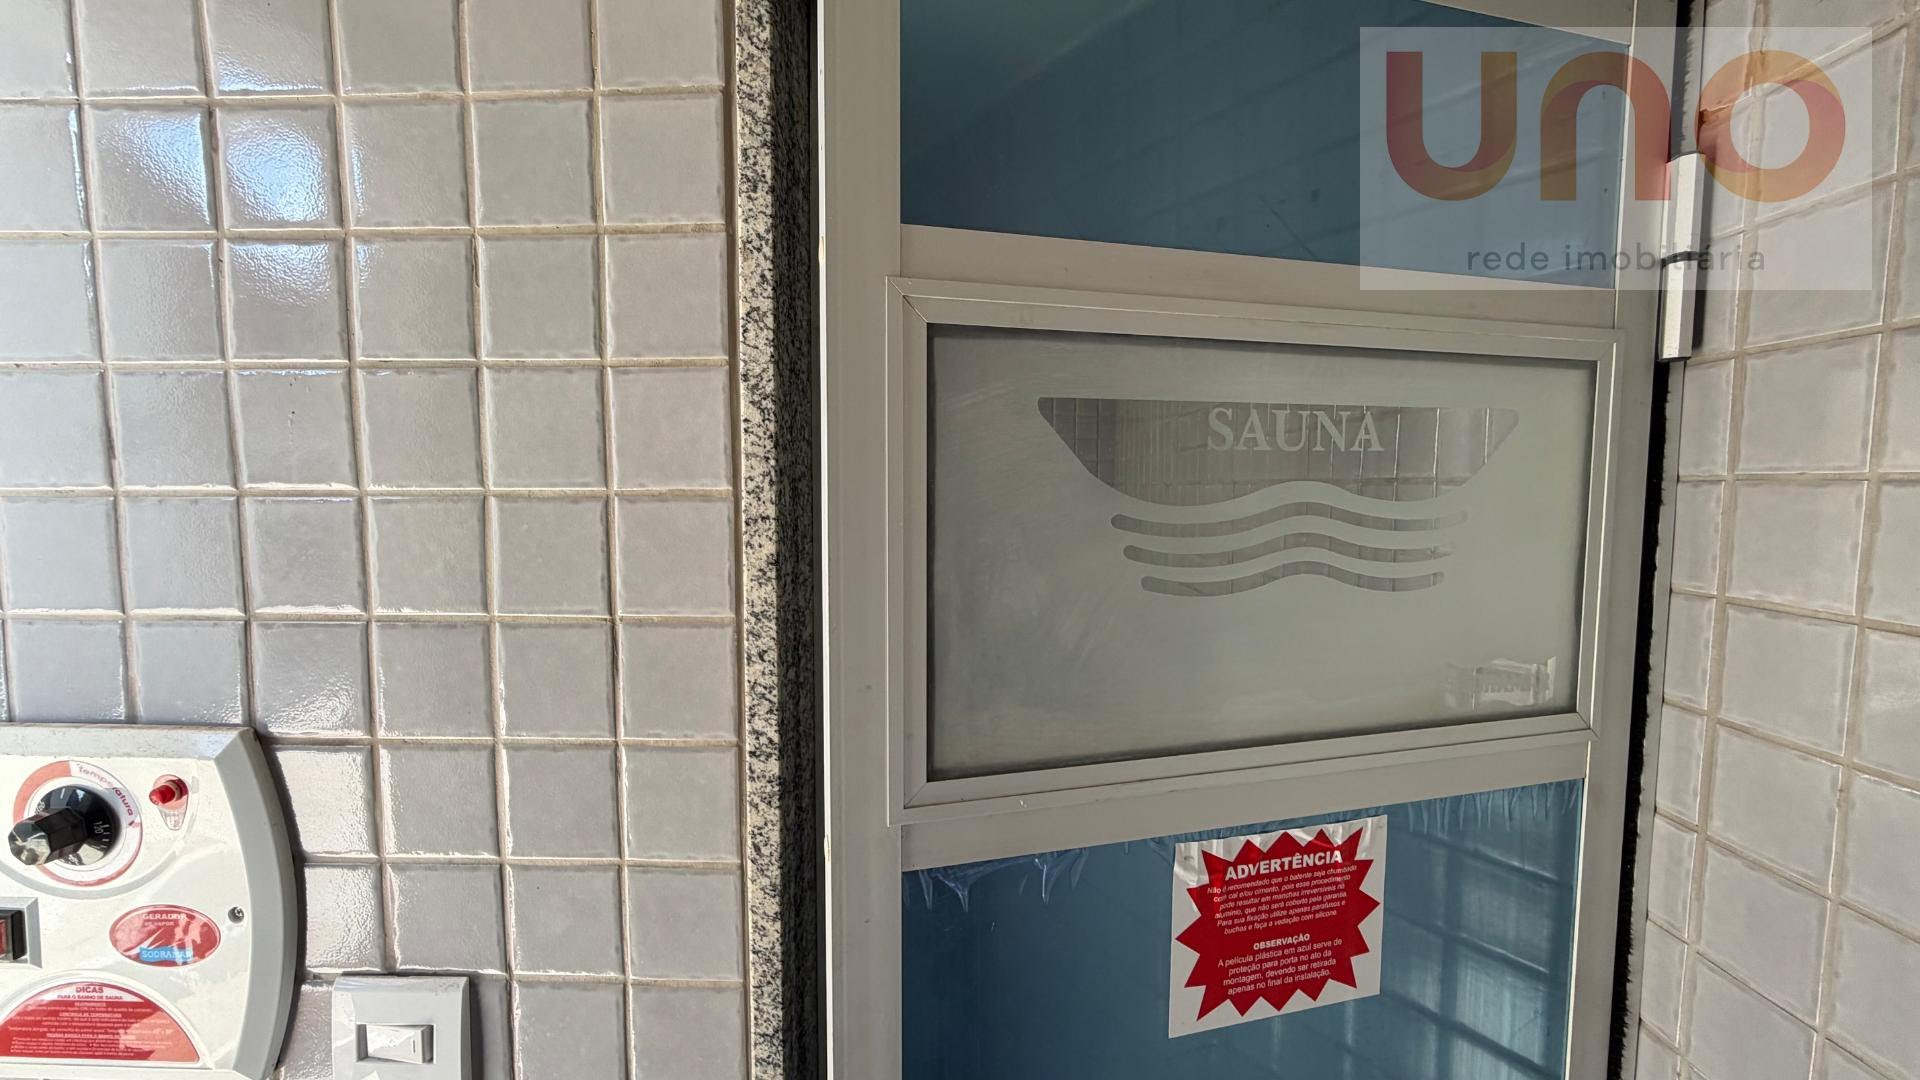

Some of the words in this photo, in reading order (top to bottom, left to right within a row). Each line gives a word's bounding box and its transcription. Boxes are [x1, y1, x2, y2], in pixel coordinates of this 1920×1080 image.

[1207, 407, 1384, 452] SAUNA
[1224, 850, 1343, 881] ADVERTÊNCIA
[142, 913, 188, 921] GERADOR
[1224, 953, 1254, 968] película
[1254, 949, 1282, 962] plástica
[1283, 946, 1296, 955] em
[1297, 943, 1312, 953] azul
[1312, 940, 1332, 950] serve
[1333, 937, 1343, 946] de
[1253, 933, 1310, 951] OBSERVAÇÃO
[1223, 972, 1264, 986] montagem,
[1265, 965, 1296, 978] devendo
[1297, 963, 1310, 972] ser
[1310, 958, 1337, 970] retirada
[1228, 963, 1261, 977] proteção
[1261, 960, 1279, 971] para
[1280, 955, 1298, 967] porta
[1310, 951, 1322, 960] ato
[75, 986, 104, 994] DICAS
[1227, 982, 1255, 996] apenas
[1256, 981, 1266, 989] no
[1267, 977, 1283, 987] final
[1283, 975, 1293, 984] da
